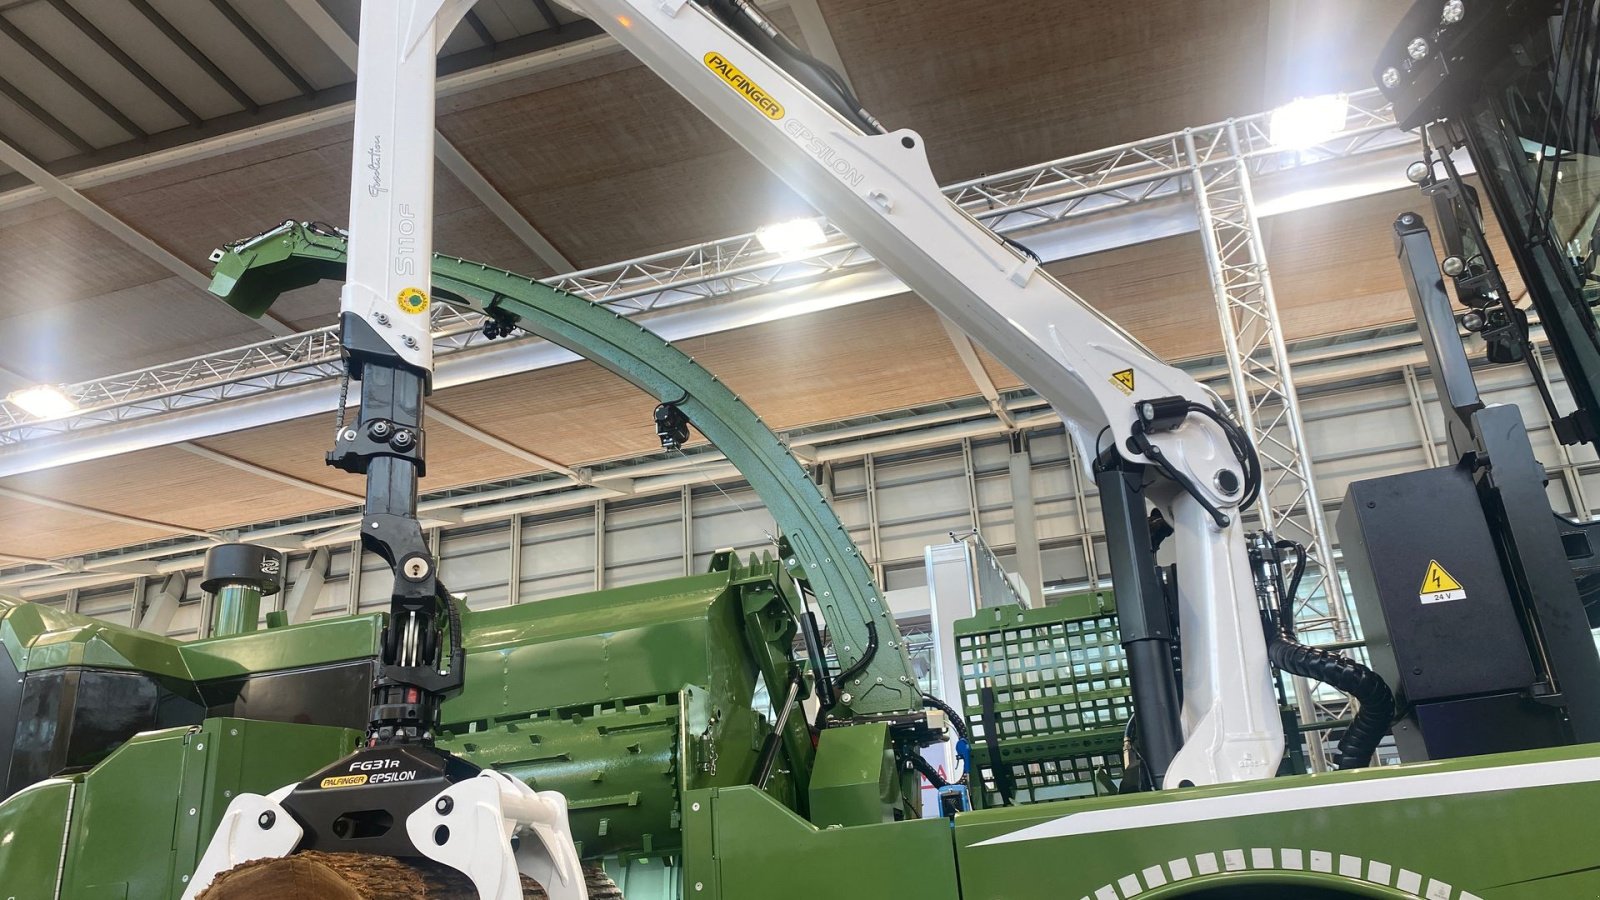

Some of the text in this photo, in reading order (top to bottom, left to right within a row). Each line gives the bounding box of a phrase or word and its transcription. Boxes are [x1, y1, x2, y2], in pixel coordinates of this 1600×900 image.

[709, 55, 780, 116] PALFINGER
[784, 118, 864, 187] EPSILON
[395, 203, 416, 276] S110F
[323, 770, 417, 787] PALFINGER EPSILON
[349, 759, 400, 772] FG31R
